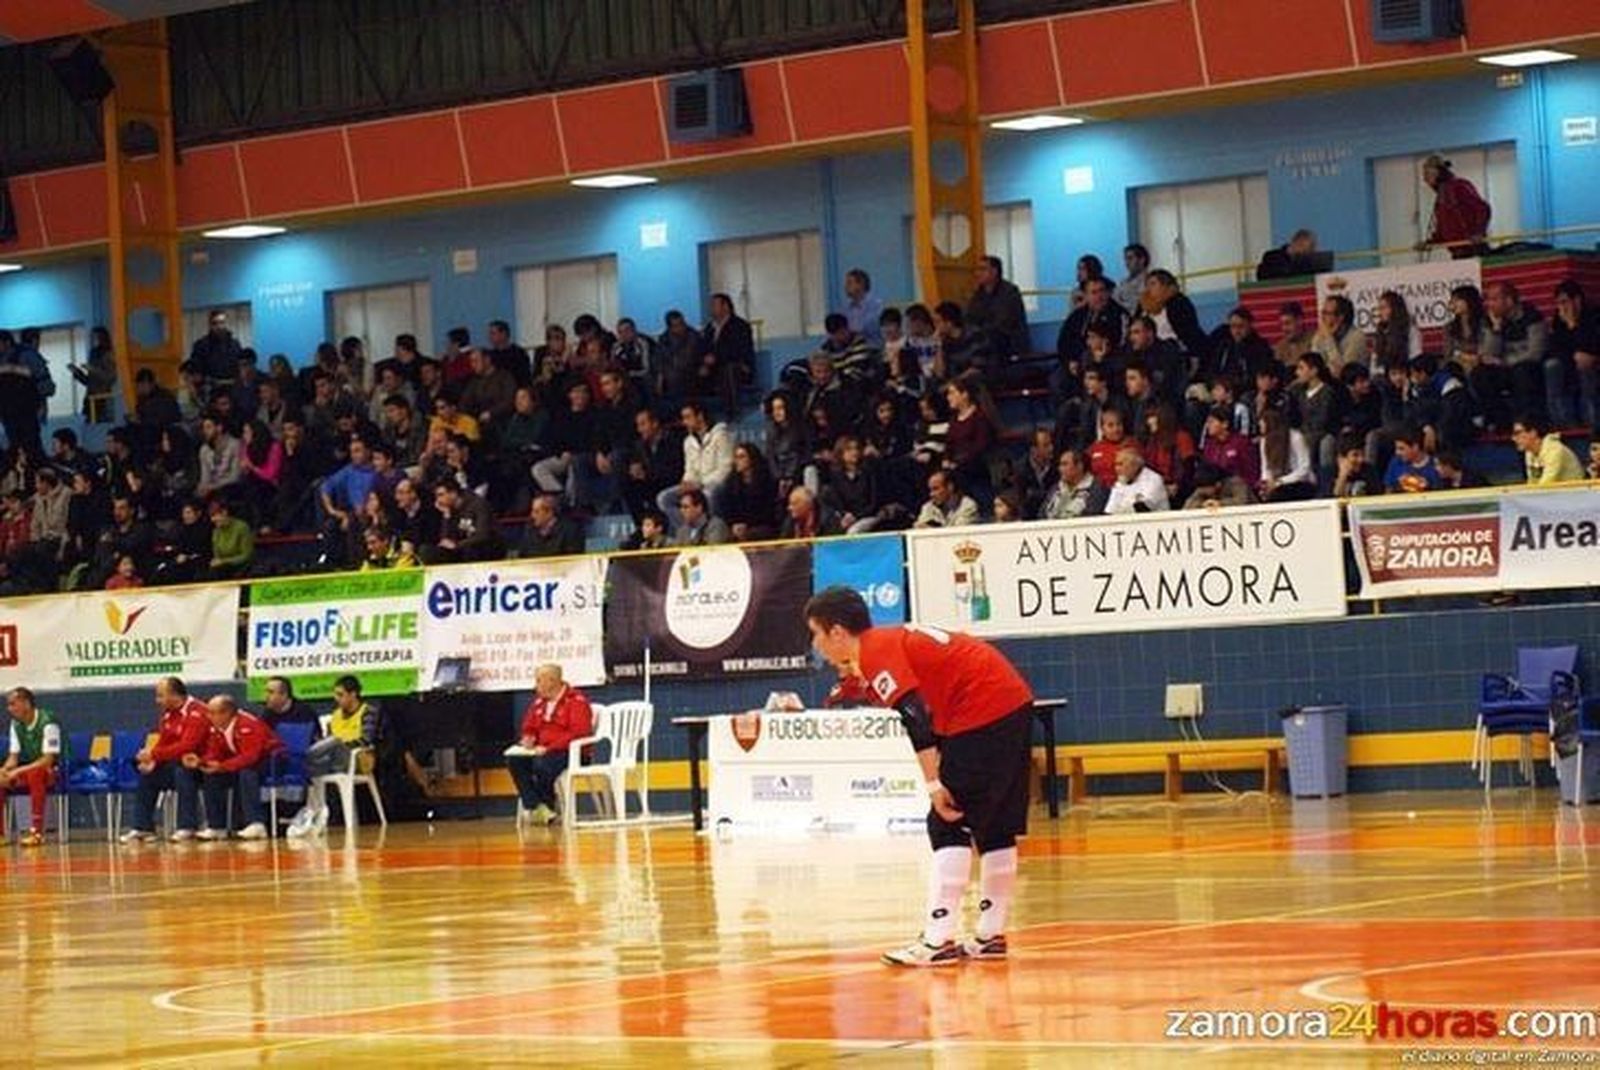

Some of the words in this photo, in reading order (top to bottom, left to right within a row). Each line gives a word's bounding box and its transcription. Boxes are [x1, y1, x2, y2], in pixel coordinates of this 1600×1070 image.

[1017, 519, 1296, 565] AYUNTAMIENTO
[1390, 530, 1472, 547] DIPUTACIÓN
[1475, 530, 1493, 543] DE
[1510, 516, 1599, 551] Area
[1387, 547, 1494, 569] ZAMORA
[1018, 578, 1069, 618] DE
[1094, 563, 1299, 615] ZAMORA
[254, 655, 304, 670] CENTRO
[308, 655, 322, 667] DE
[325, 648, 413, 666] FISIOTERAPIA
